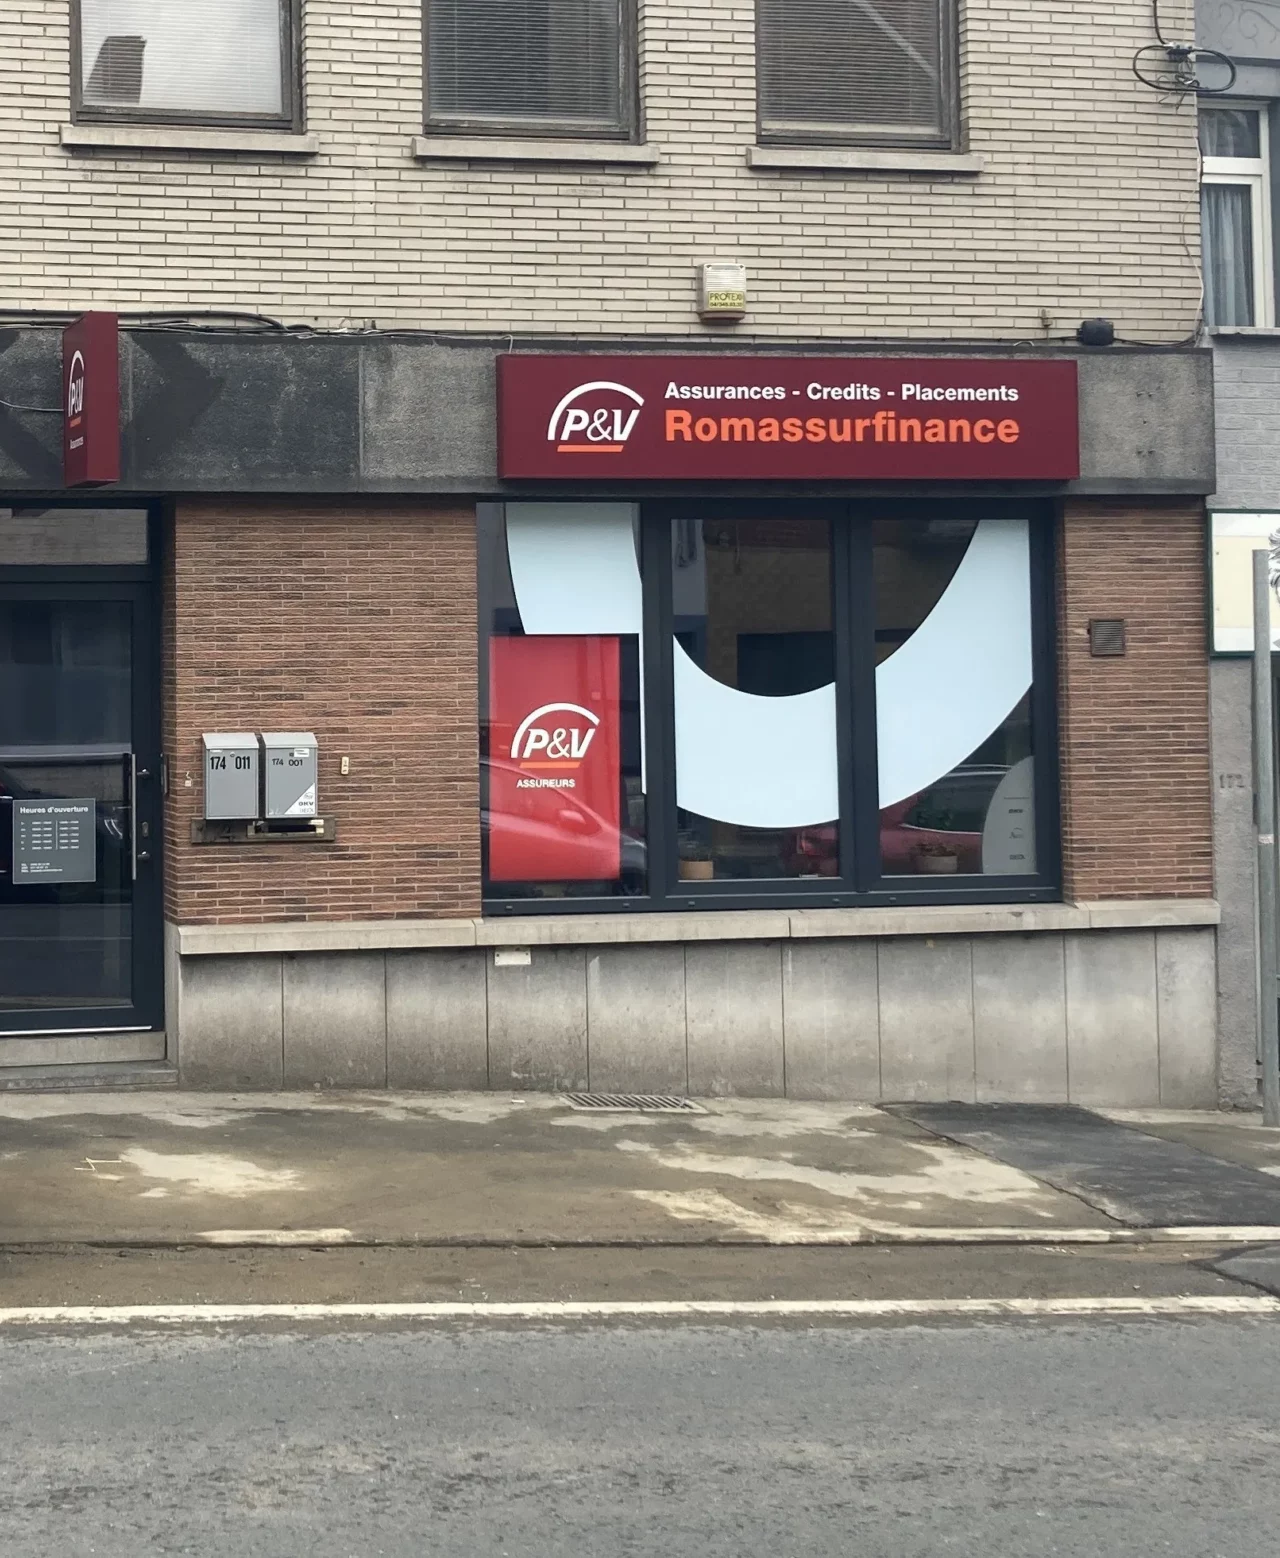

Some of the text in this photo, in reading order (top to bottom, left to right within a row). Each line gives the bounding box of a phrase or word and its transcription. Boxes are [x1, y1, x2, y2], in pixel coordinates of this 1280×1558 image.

[664, 381, 786, 400] Assurances
[806, 383, 882, 401] Credits
[901, 384, 1019, 402] Placements
[560, 407, 642, 442] P&V
[664, 409, 1020, 443] Romassurfinance
[522, 727, 596, 759] P&V
[210, 755, 251, 770] 174 011
[271, 758, 303, 767] 174 001
[516, 779, 575, 788] ASSUREURS
